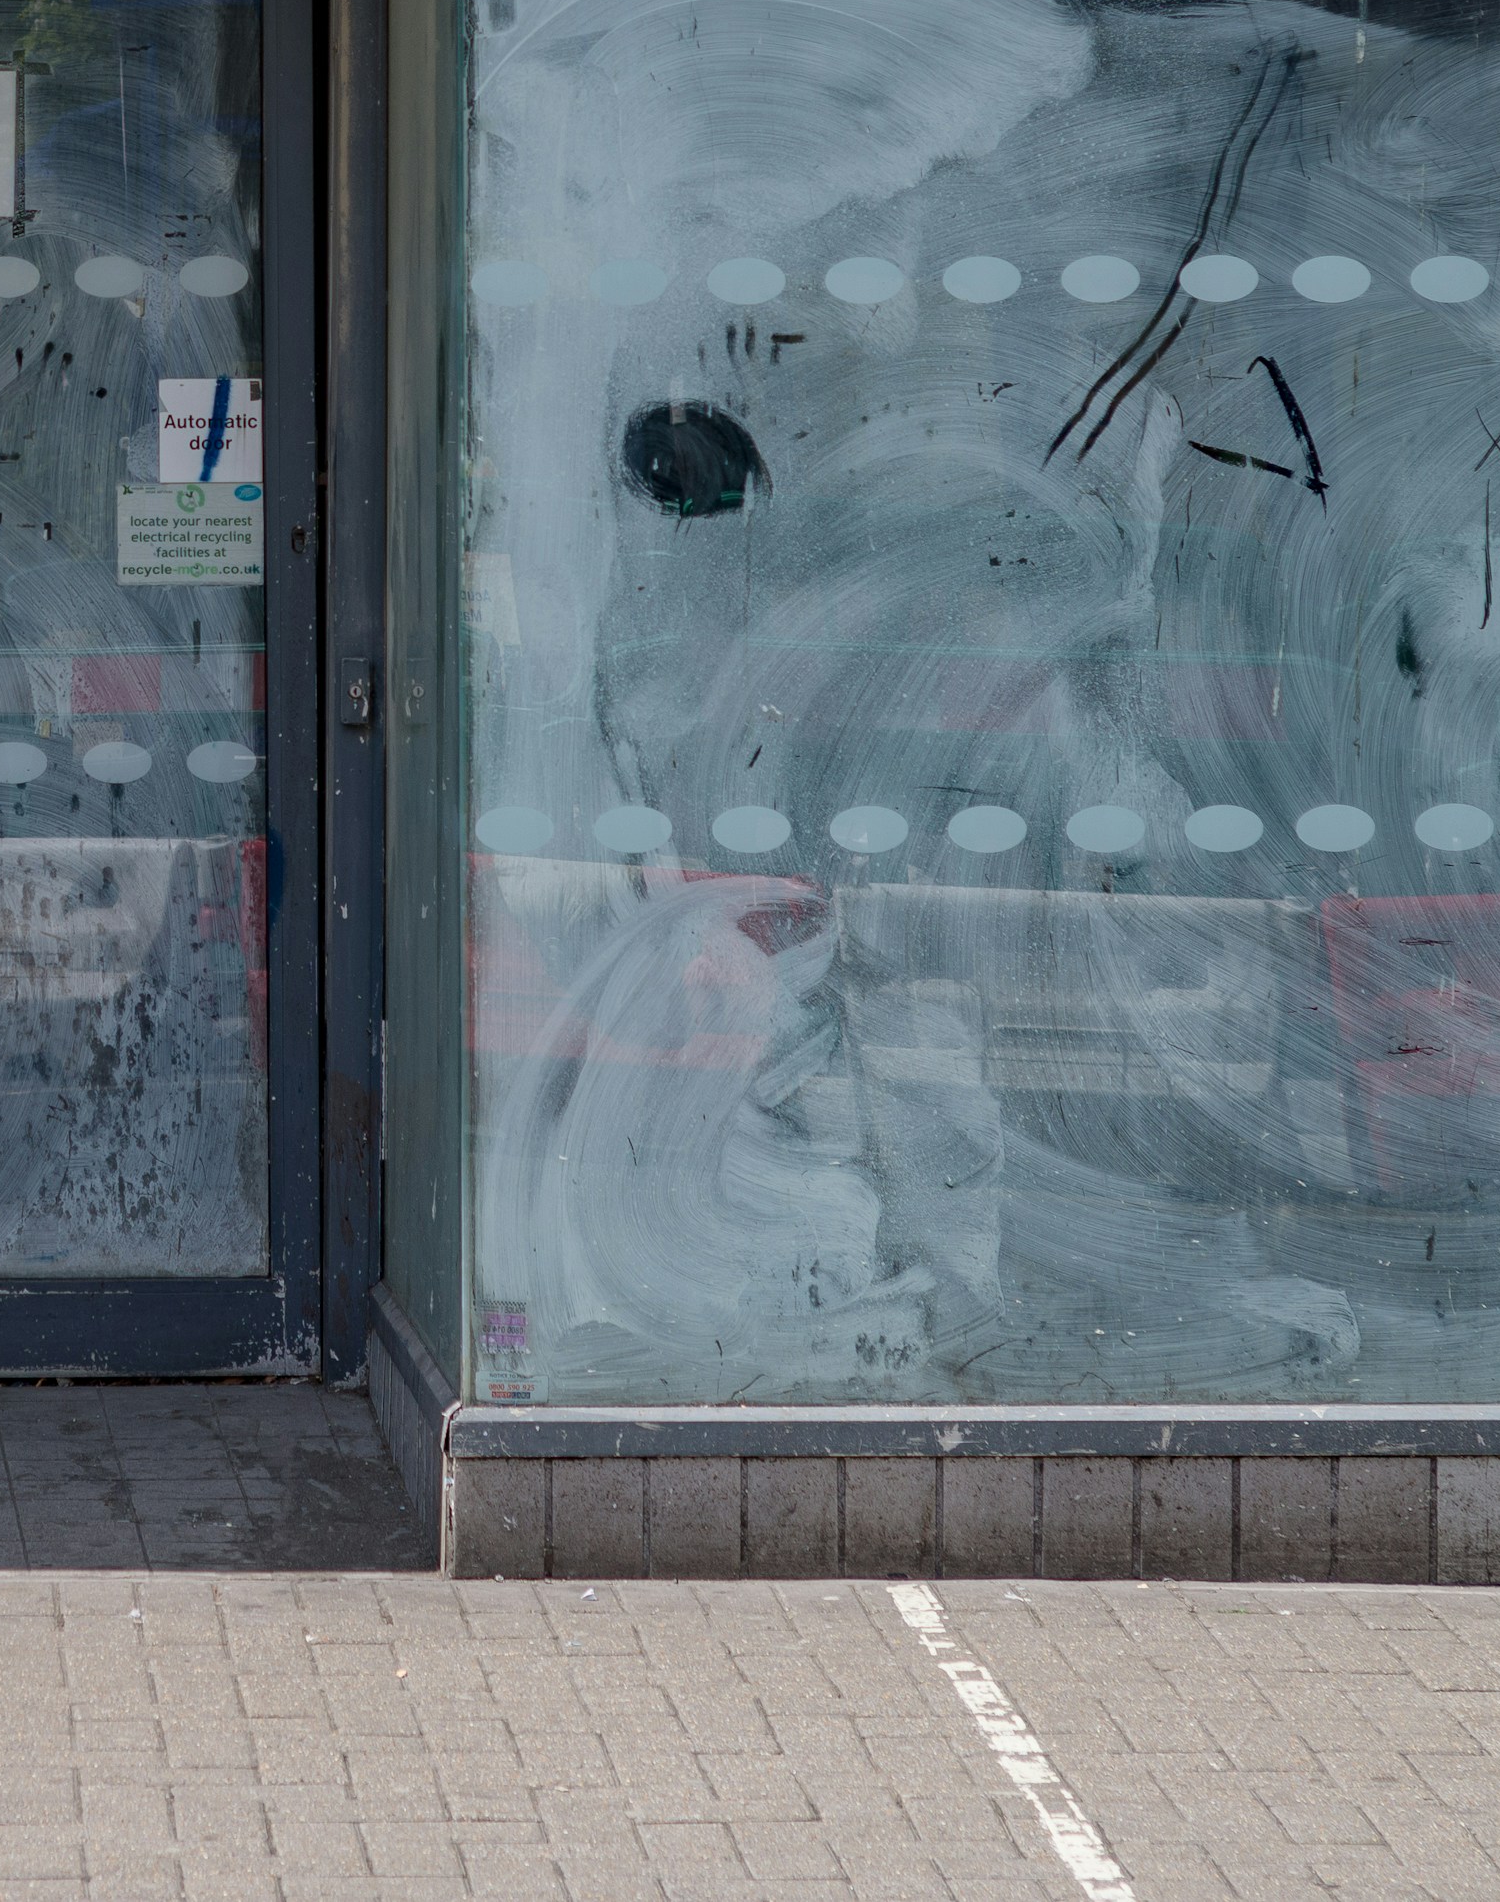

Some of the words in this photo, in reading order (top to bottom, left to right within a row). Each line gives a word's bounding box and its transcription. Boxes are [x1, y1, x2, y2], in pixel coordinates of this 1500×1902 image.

[189, 435, 233, 451] door
[130, 515, 169, 527] locate
[173, 517, 201, 530] your
[205, 516, 253, 527] nearest
[131, 531, 190, 543] electrical
[194, 531, 252, 545] recycling
[156, 547, 210, 558] facilities
[214, 548, 226, 558] at
[122, 563, 260, 578] recycle-more.co.uk
